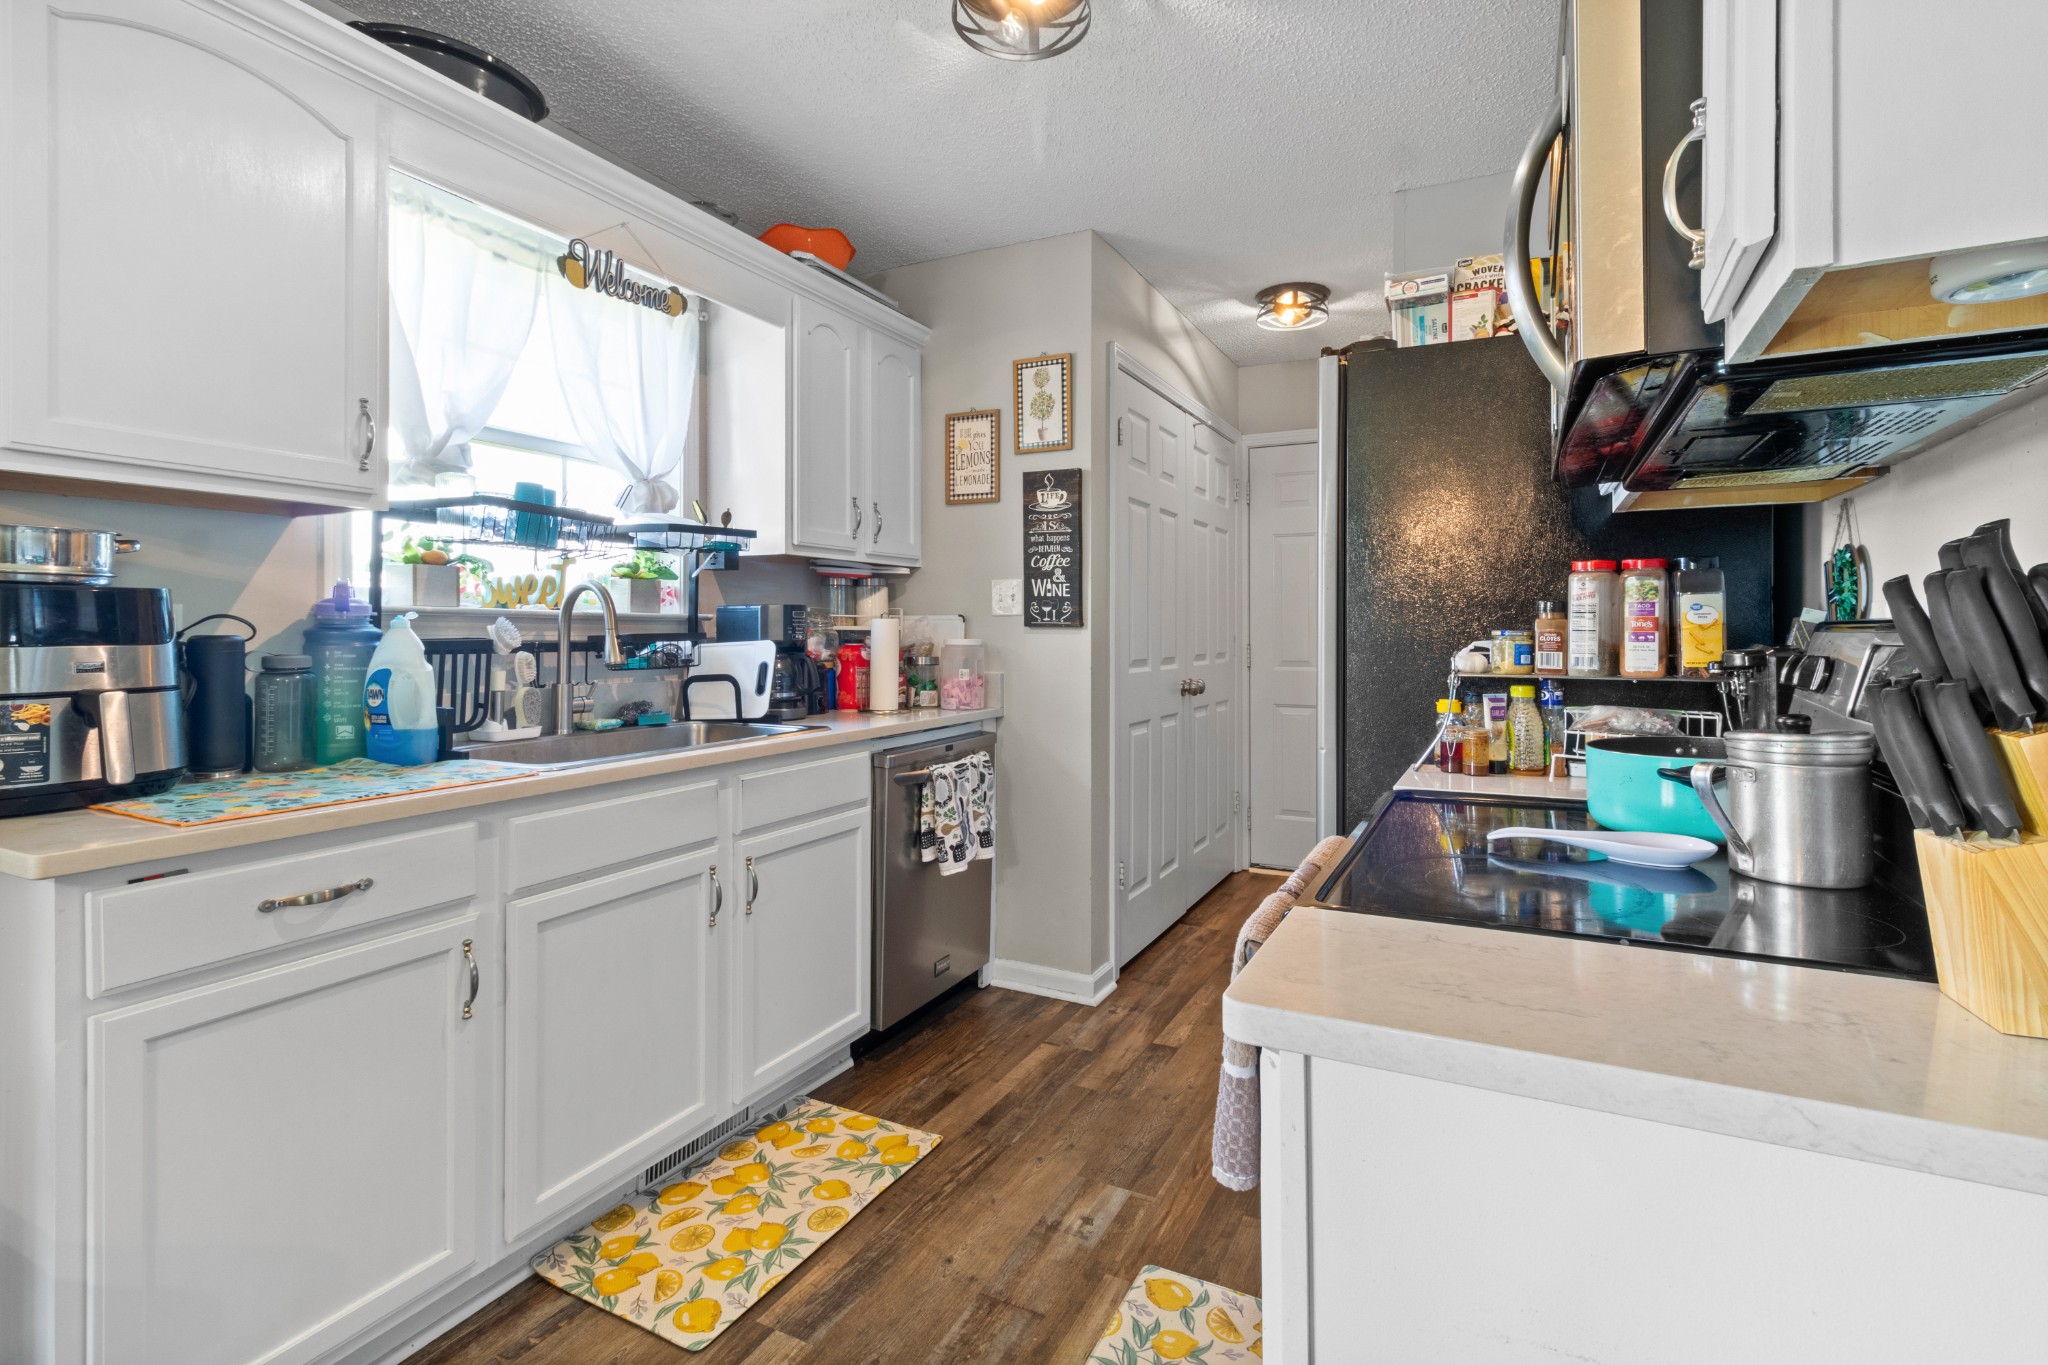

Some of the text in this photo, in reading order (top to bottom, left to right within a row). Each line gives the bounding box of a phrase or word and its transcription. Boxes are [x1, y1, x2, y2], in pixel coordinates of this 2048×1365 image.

[569, 239, 672, 313] Welcome
[1457, 278, 1506, 292] CRACKE
[973, 431, 987, 440] gives
[968, 440, 984, 451] YOU
[955, 450, 991, 471] LEMONS
[955, 474, 991, 487] LEMONADE
[1040, 491, 1060, 505] LIFE
[1043, 520, 1056, 531] IS
[1030, 533, 1071, 544] what happens
[1038, 544, 1061, 553] BETWEEN
[1030, 553, 1071, 571] Coffee
[1052, 567, 1067, 583] &
[1031, 578, 1071, 597] WINE
[1630, 620, 1653, 628] Tone's
[366, 689, 384, 700] DAWN
